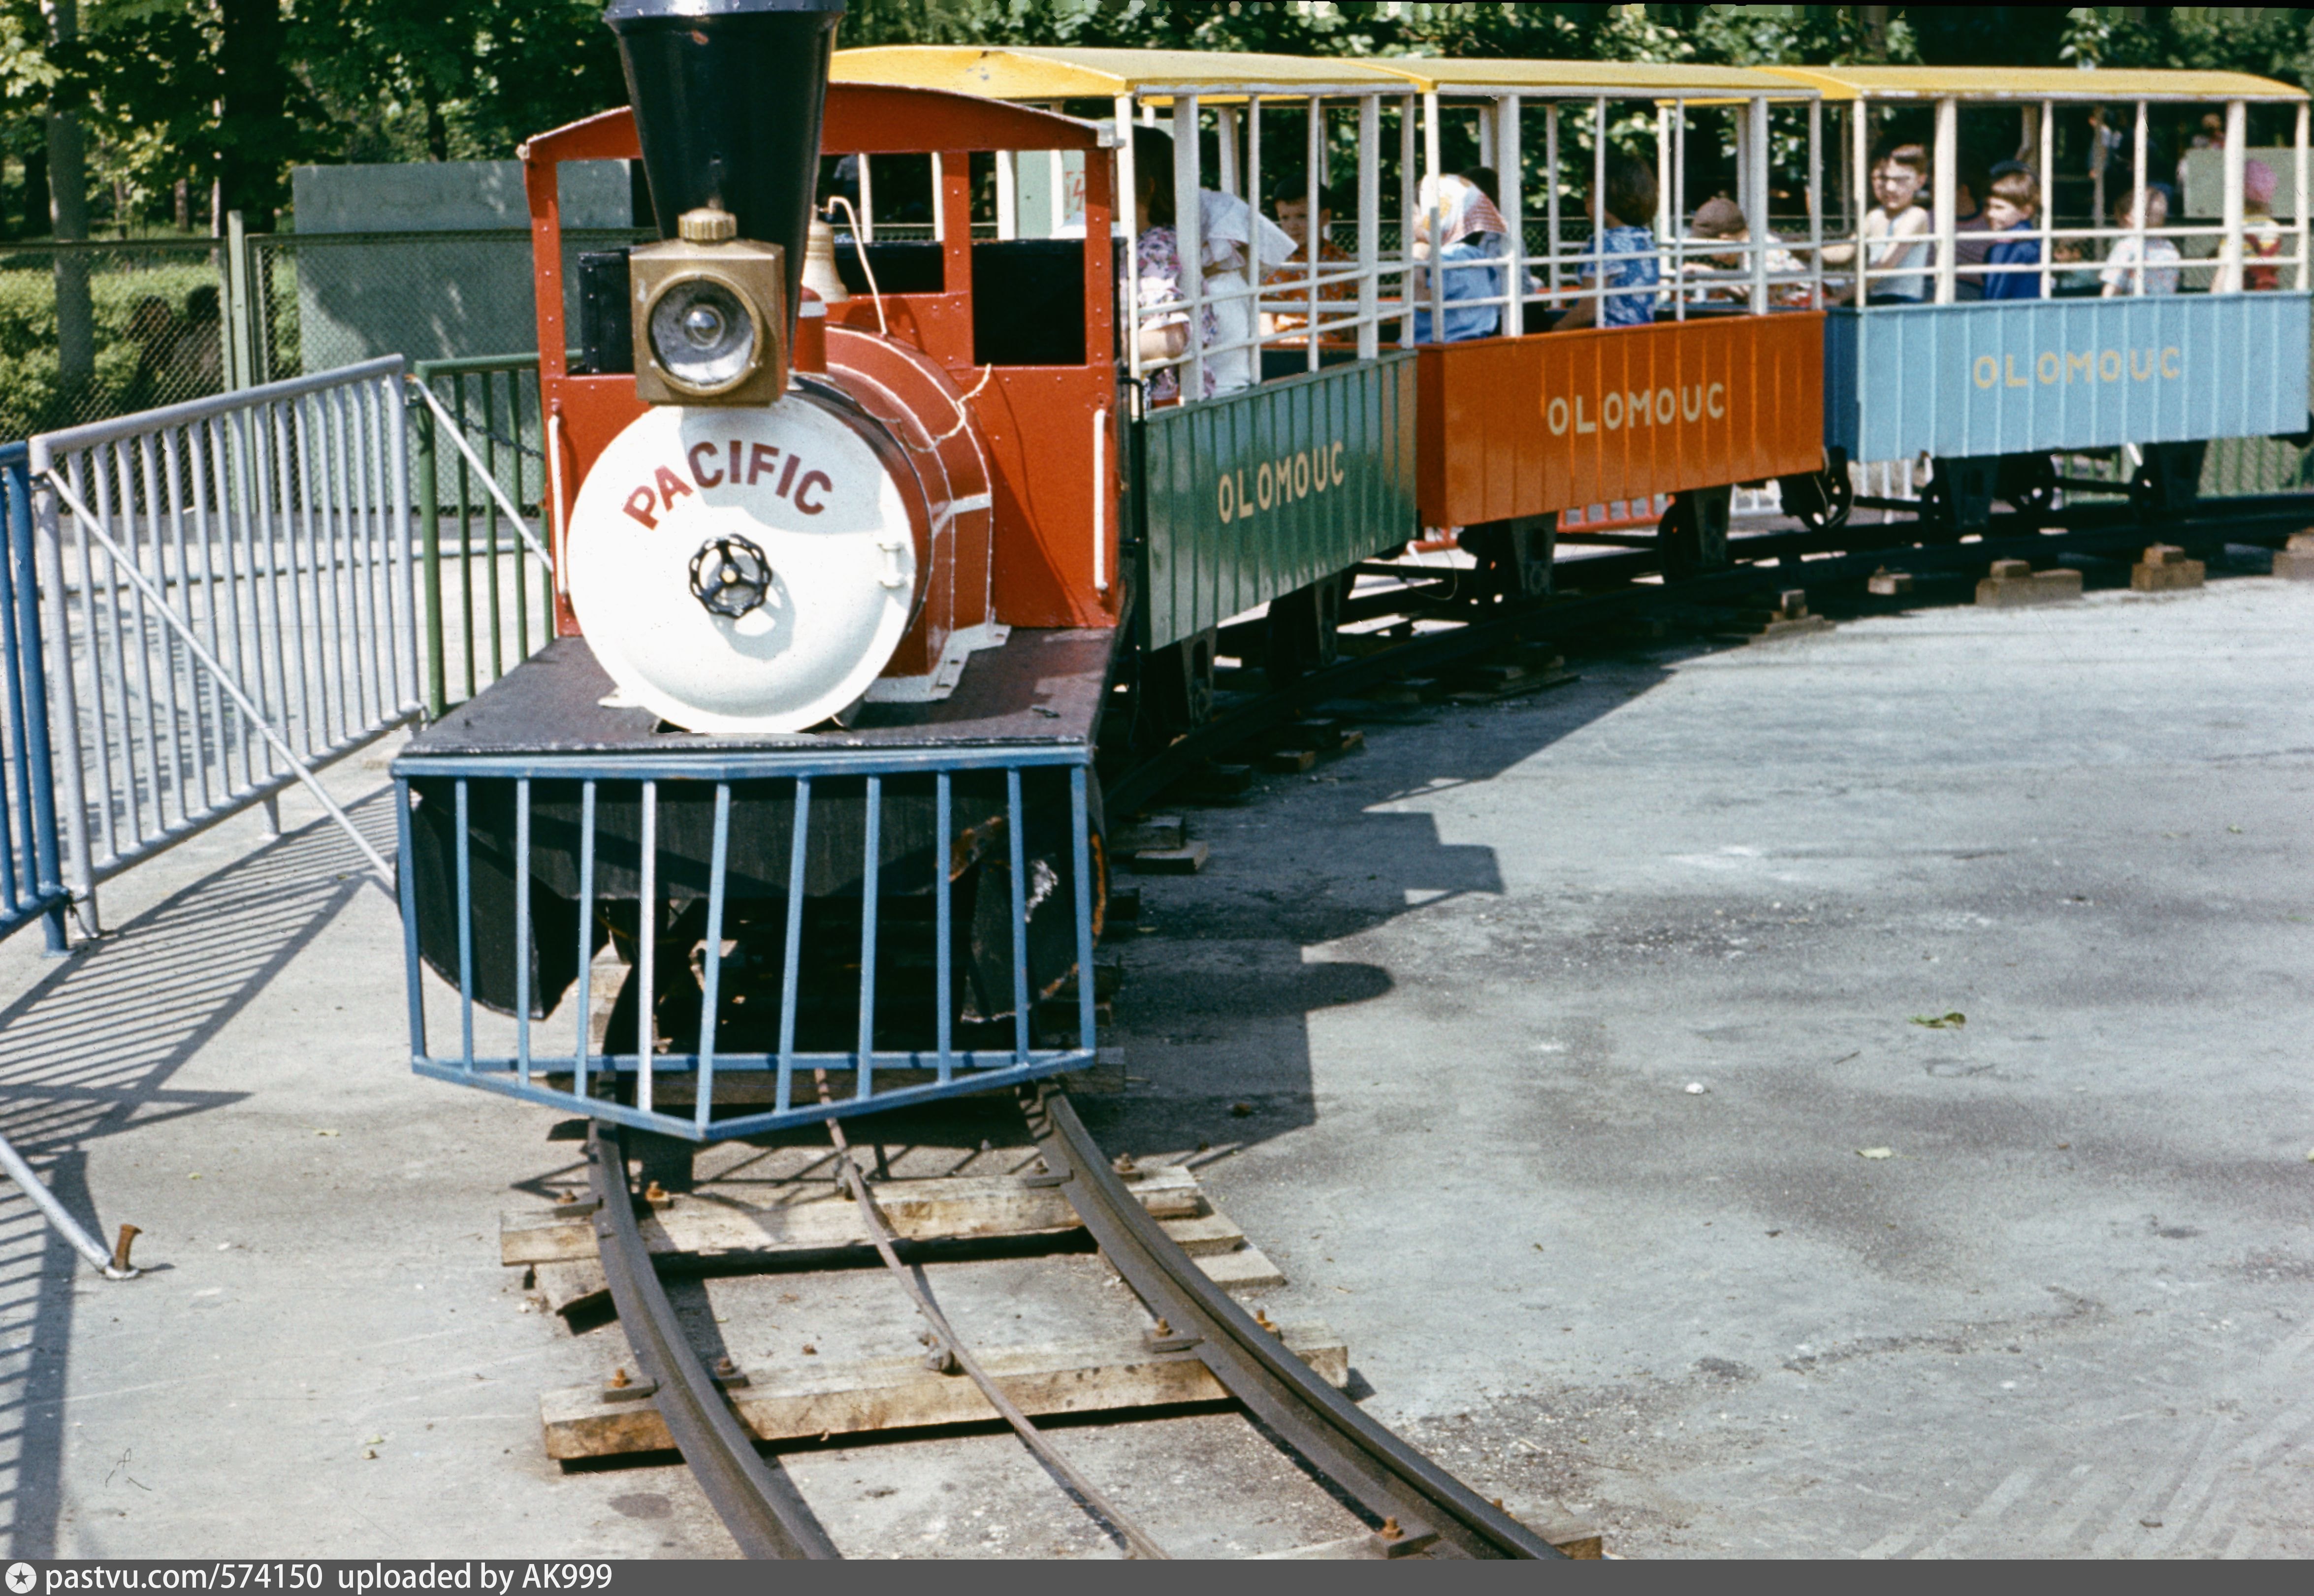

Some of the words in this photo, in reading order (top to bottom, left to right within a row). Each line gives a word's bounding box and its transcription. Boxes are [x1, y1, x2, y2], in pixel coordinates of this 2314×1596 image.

[1973, 347, 2181, 389] OLOMOUC
[1547, 382, 1725, 436] OLOMOUC
[622, 440, 833, 530] PACIFIC
[1218, 440, 1345, 524] OLOMOUC
